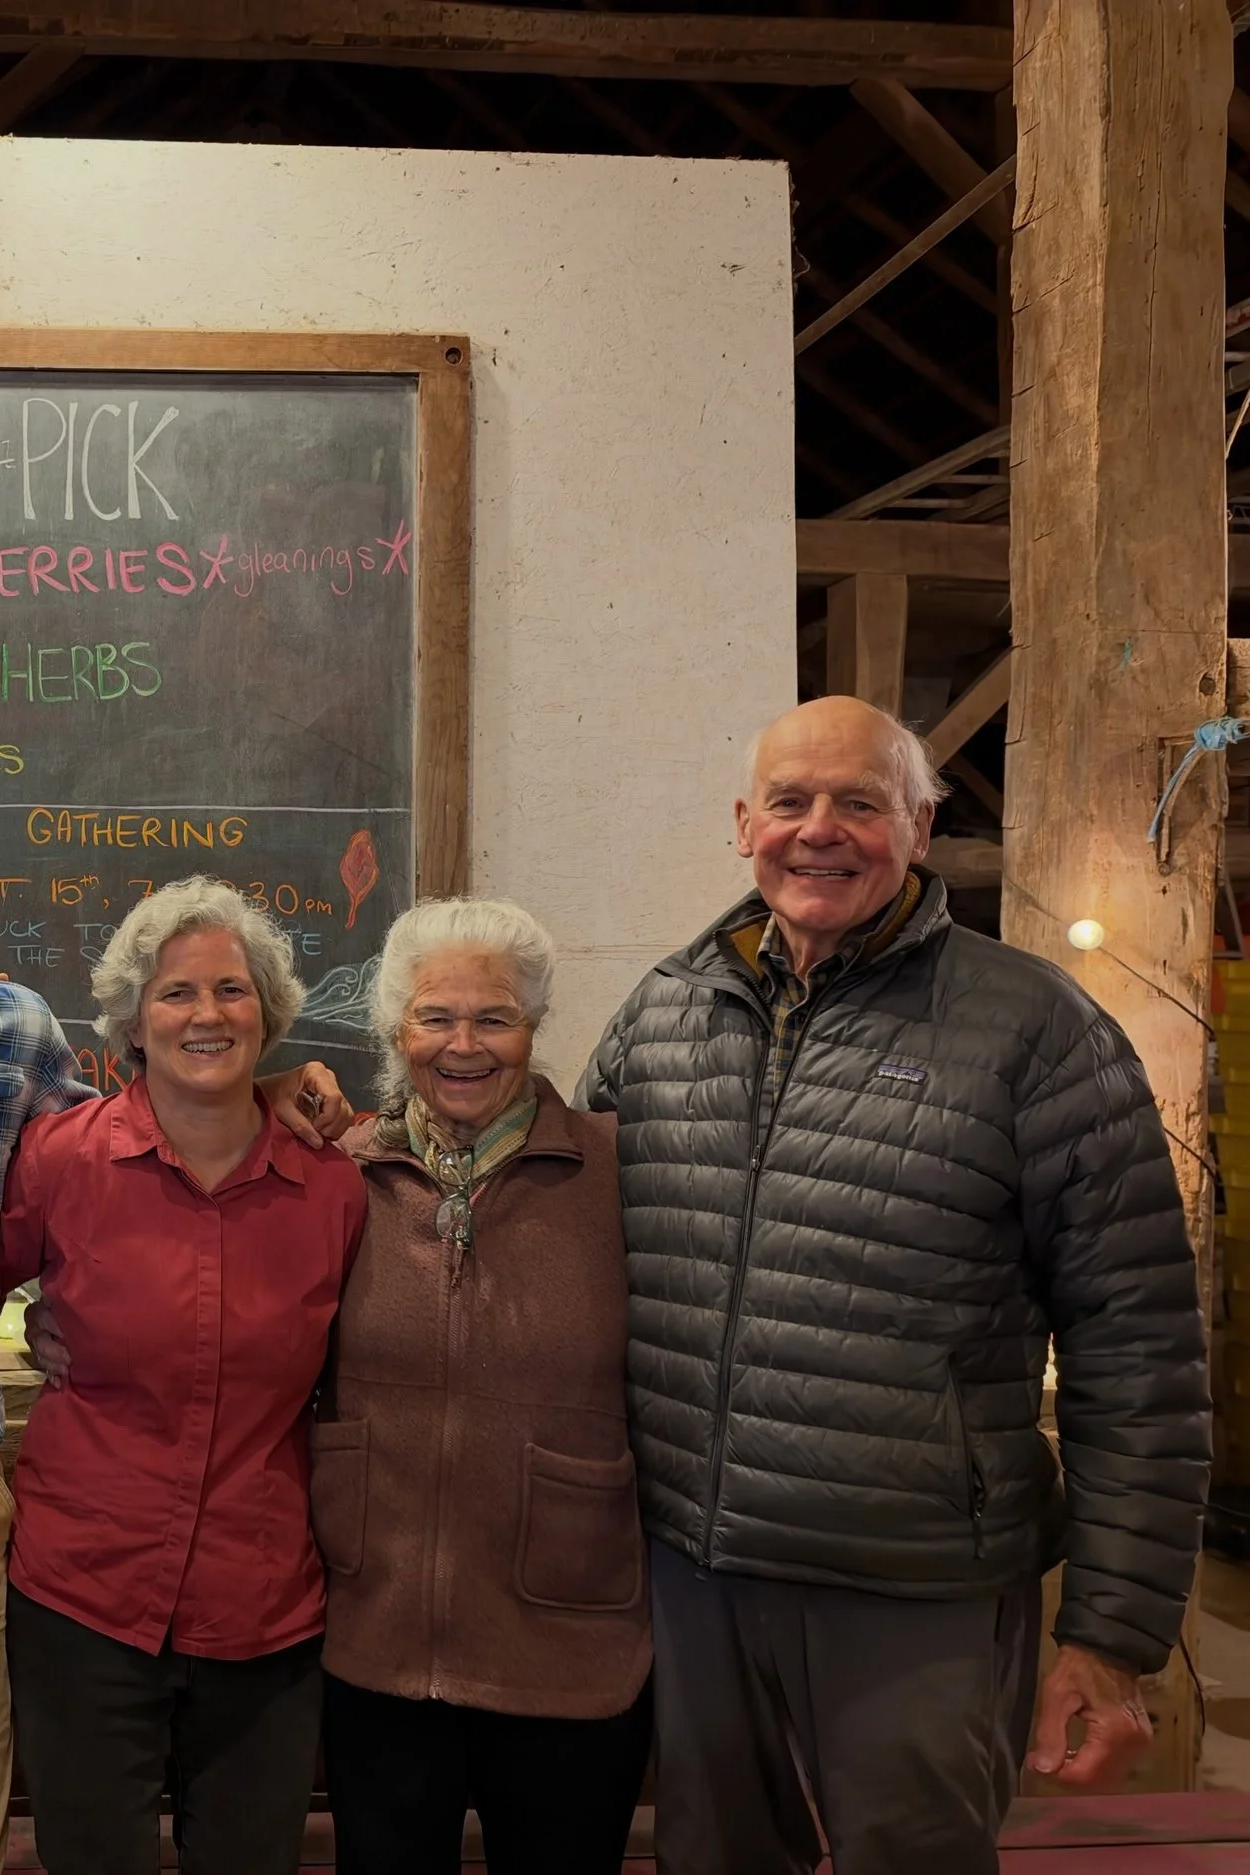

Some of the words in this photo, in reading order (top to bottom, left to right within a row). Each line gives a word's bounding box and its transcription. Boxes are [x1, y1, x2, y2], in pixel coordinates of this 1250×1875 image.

[1, 641, 163, 702] HERBS
[26, 807, 249, 850] GATHERING
[8, 944, 66, 968] THE
